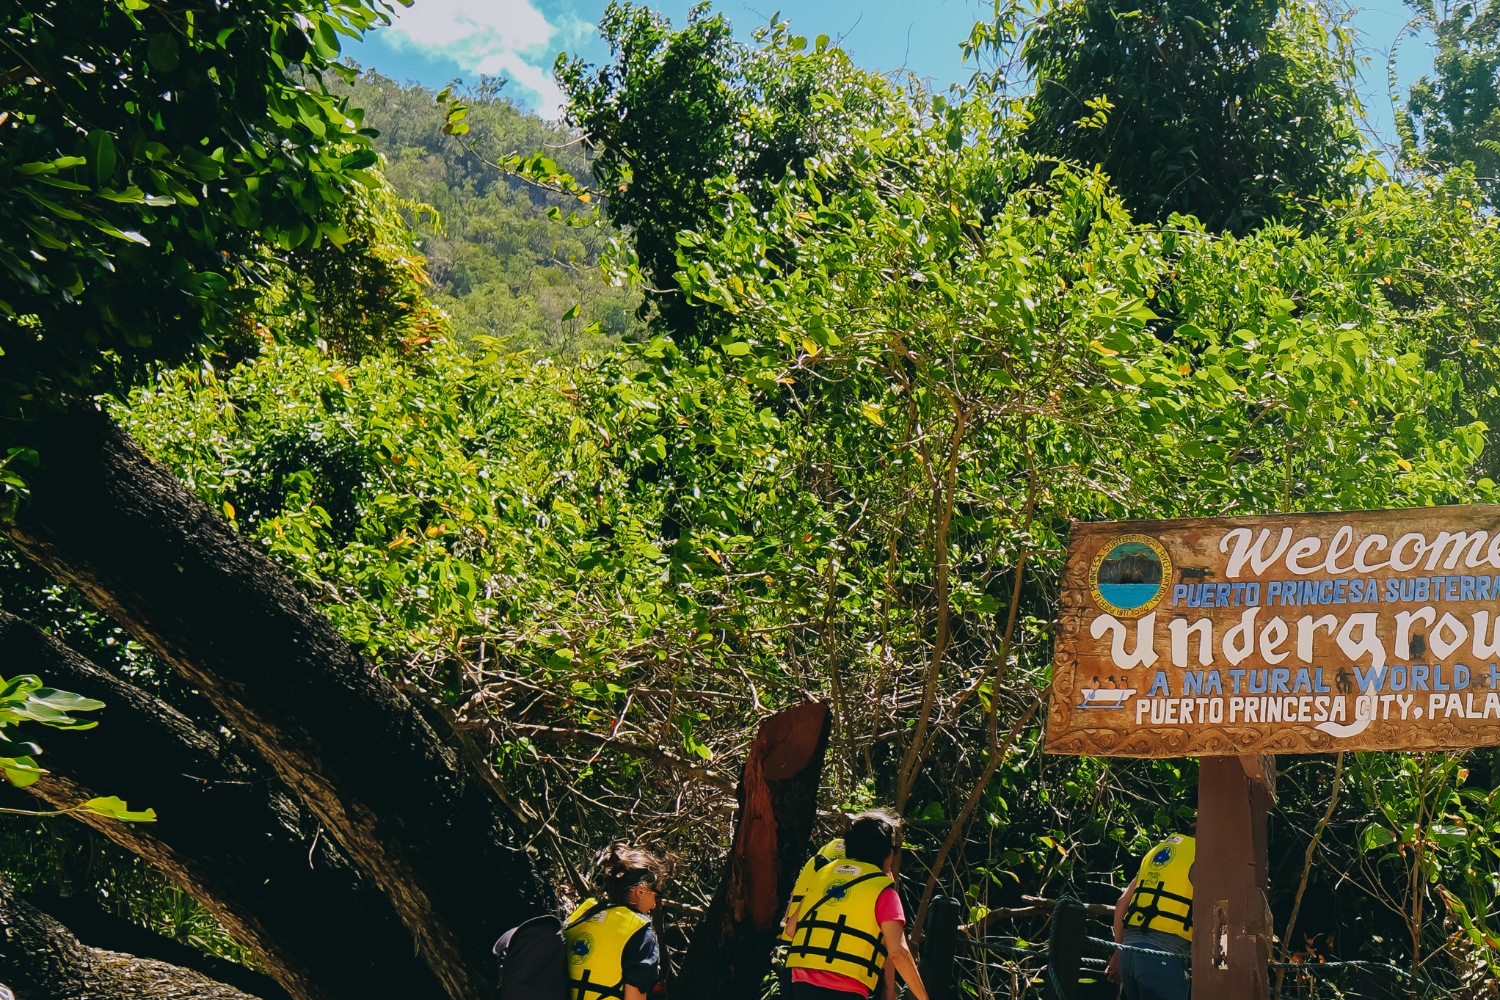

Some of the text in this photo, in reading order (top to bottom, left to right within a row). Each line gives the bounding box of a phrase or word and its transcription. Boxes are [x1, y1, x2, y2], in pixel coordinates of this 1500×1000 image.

[1173, 582, 1260, 608] PUERTO
[1267, 578, 1379, 606] PRINCESA
[1147, 670, 1170, 697] A
[1183, 667, 1331, 697] NATURAL
[1353, 664, 1471, 693] WORLD
[1136, 698, 1224, 725] PUERTO
[1229, 695, 1346, 724] PRINCESA
[1355, 693, 1424, 721] CITY,
